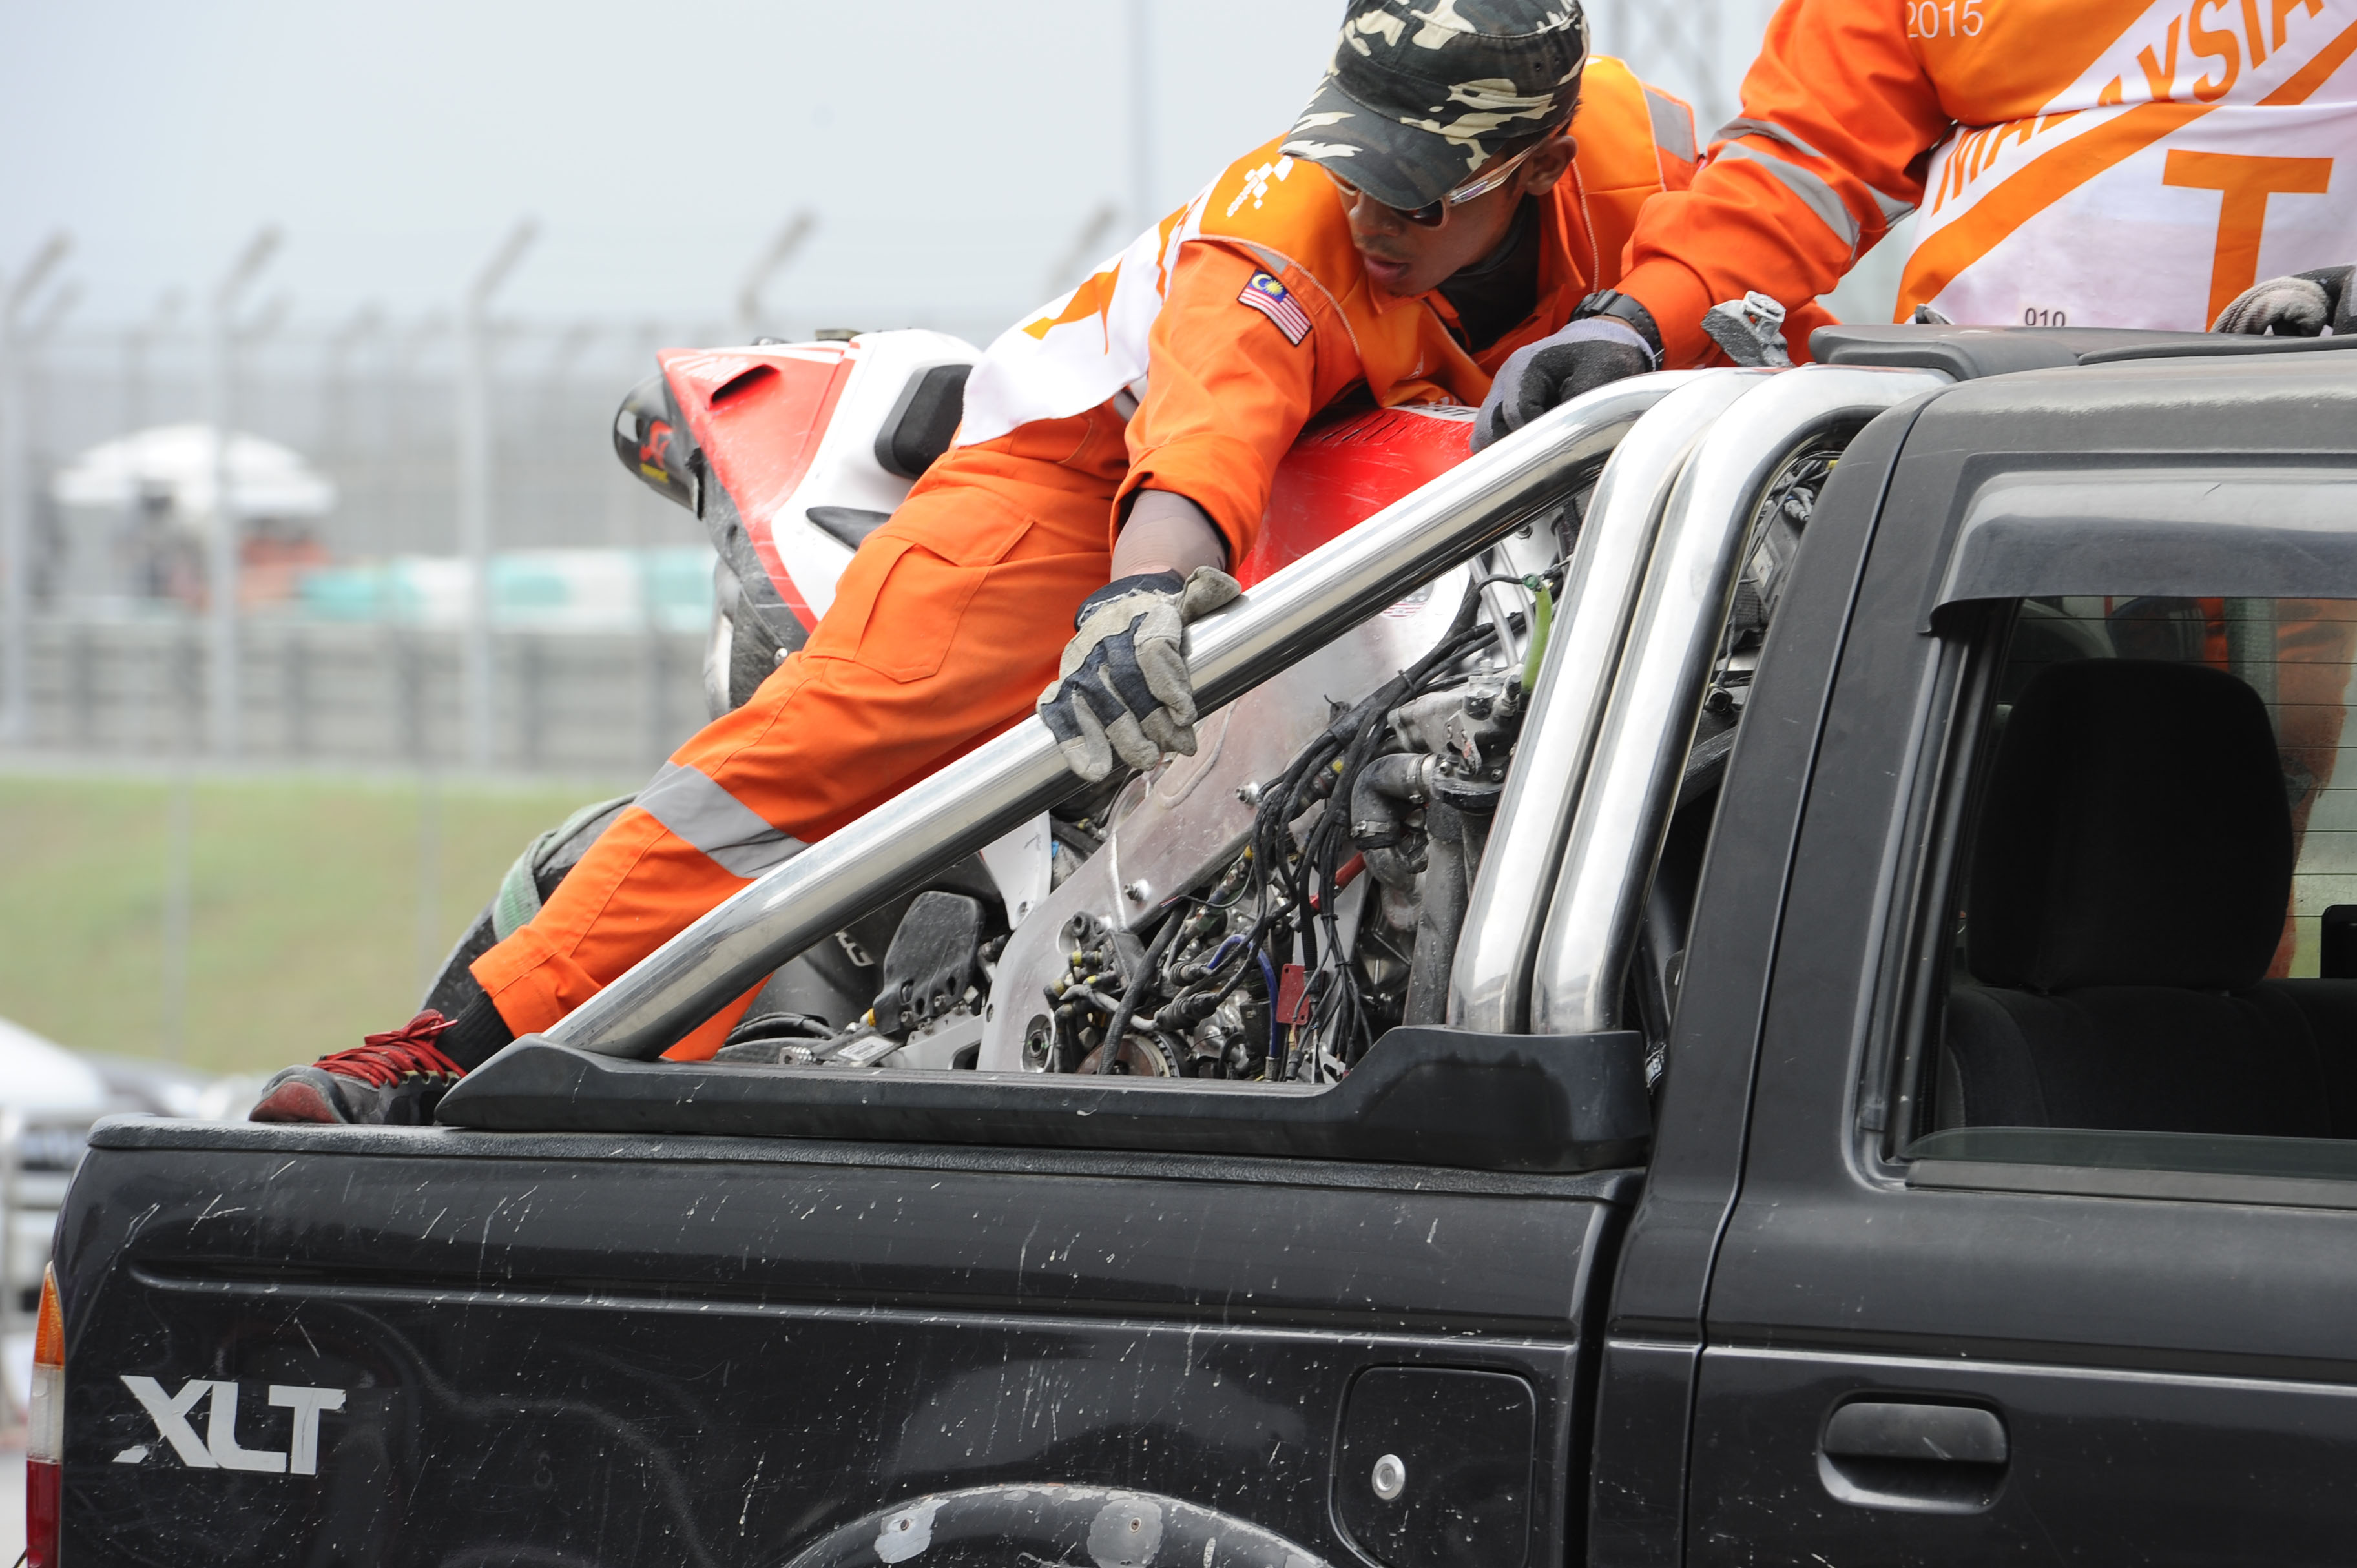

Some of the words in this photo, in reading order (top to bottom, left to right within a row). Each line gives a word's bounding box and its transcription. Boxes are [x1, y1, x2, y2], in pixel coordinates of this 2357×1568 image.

[1907, 0, 1984, 39] 2015
[2162, 149, 2334, 332] T
[2024, 307, 2066, 327] 010
[112, 1374, 346, 1476] XLT
